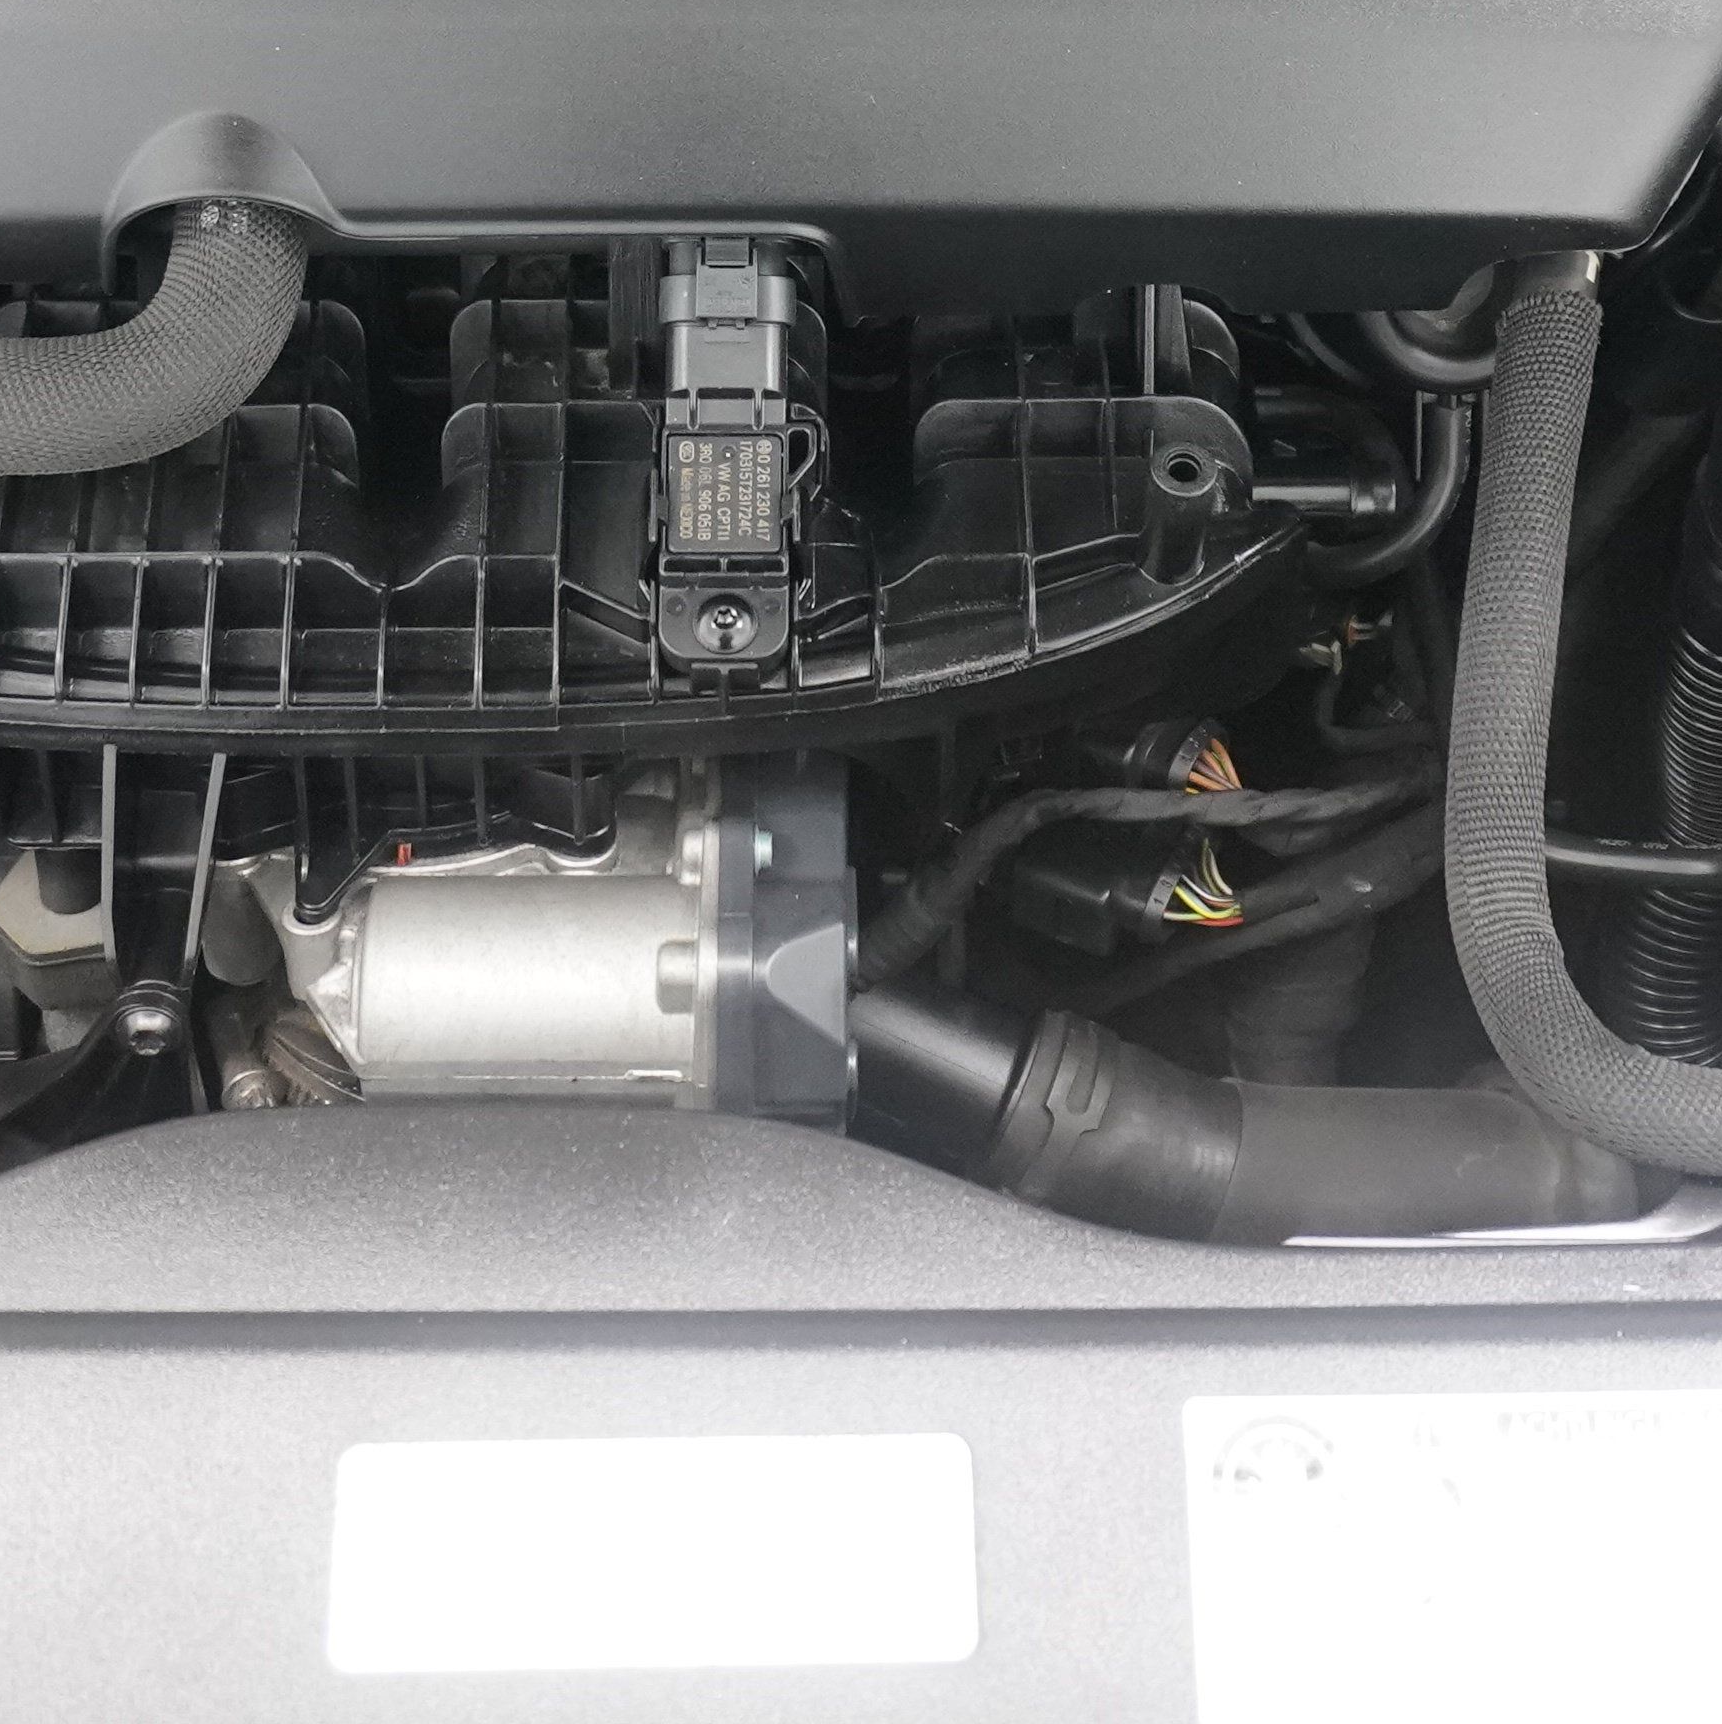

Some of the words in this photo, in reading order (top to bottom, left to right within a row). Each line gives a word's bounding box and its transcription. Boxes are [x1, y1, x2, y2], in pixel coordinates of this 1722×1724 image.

[757, 466, 771, 488] 261
[717, 484, 731, 502] AG
[756, 492, 771, 516] 230
[756, 519, 771, 541] 417
